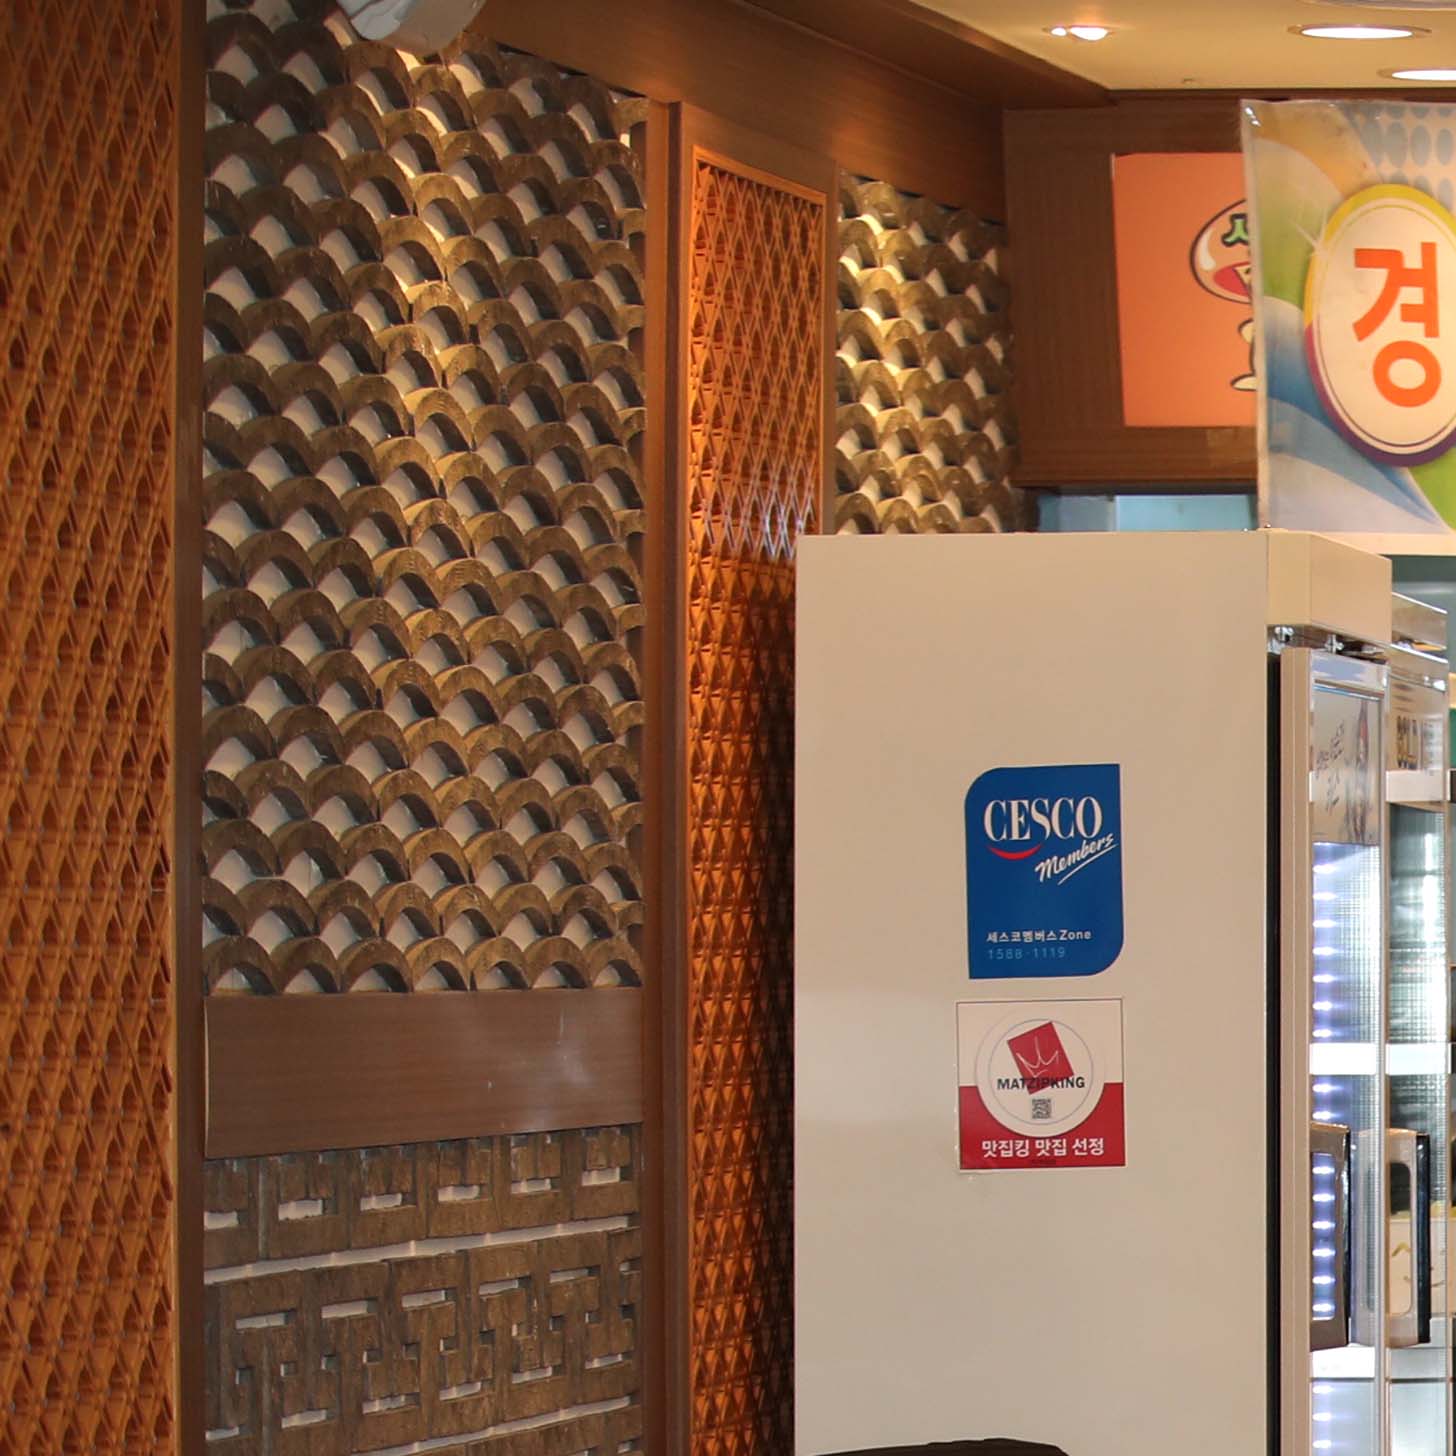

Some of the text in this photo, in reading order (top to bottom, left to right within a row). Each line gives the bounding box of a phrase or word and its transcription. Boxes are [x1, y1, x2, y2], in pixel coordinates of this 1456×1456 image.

[1354, 241, 1442, 408] 경
[983, 796, 1103, 842] CESCO
[1033, 831, 1117, 884] Members
[997, 1076, 1086, 1091] MATZIPKING
[981, 1137, 1104, 1158] 맛집킹 맛집 선정
